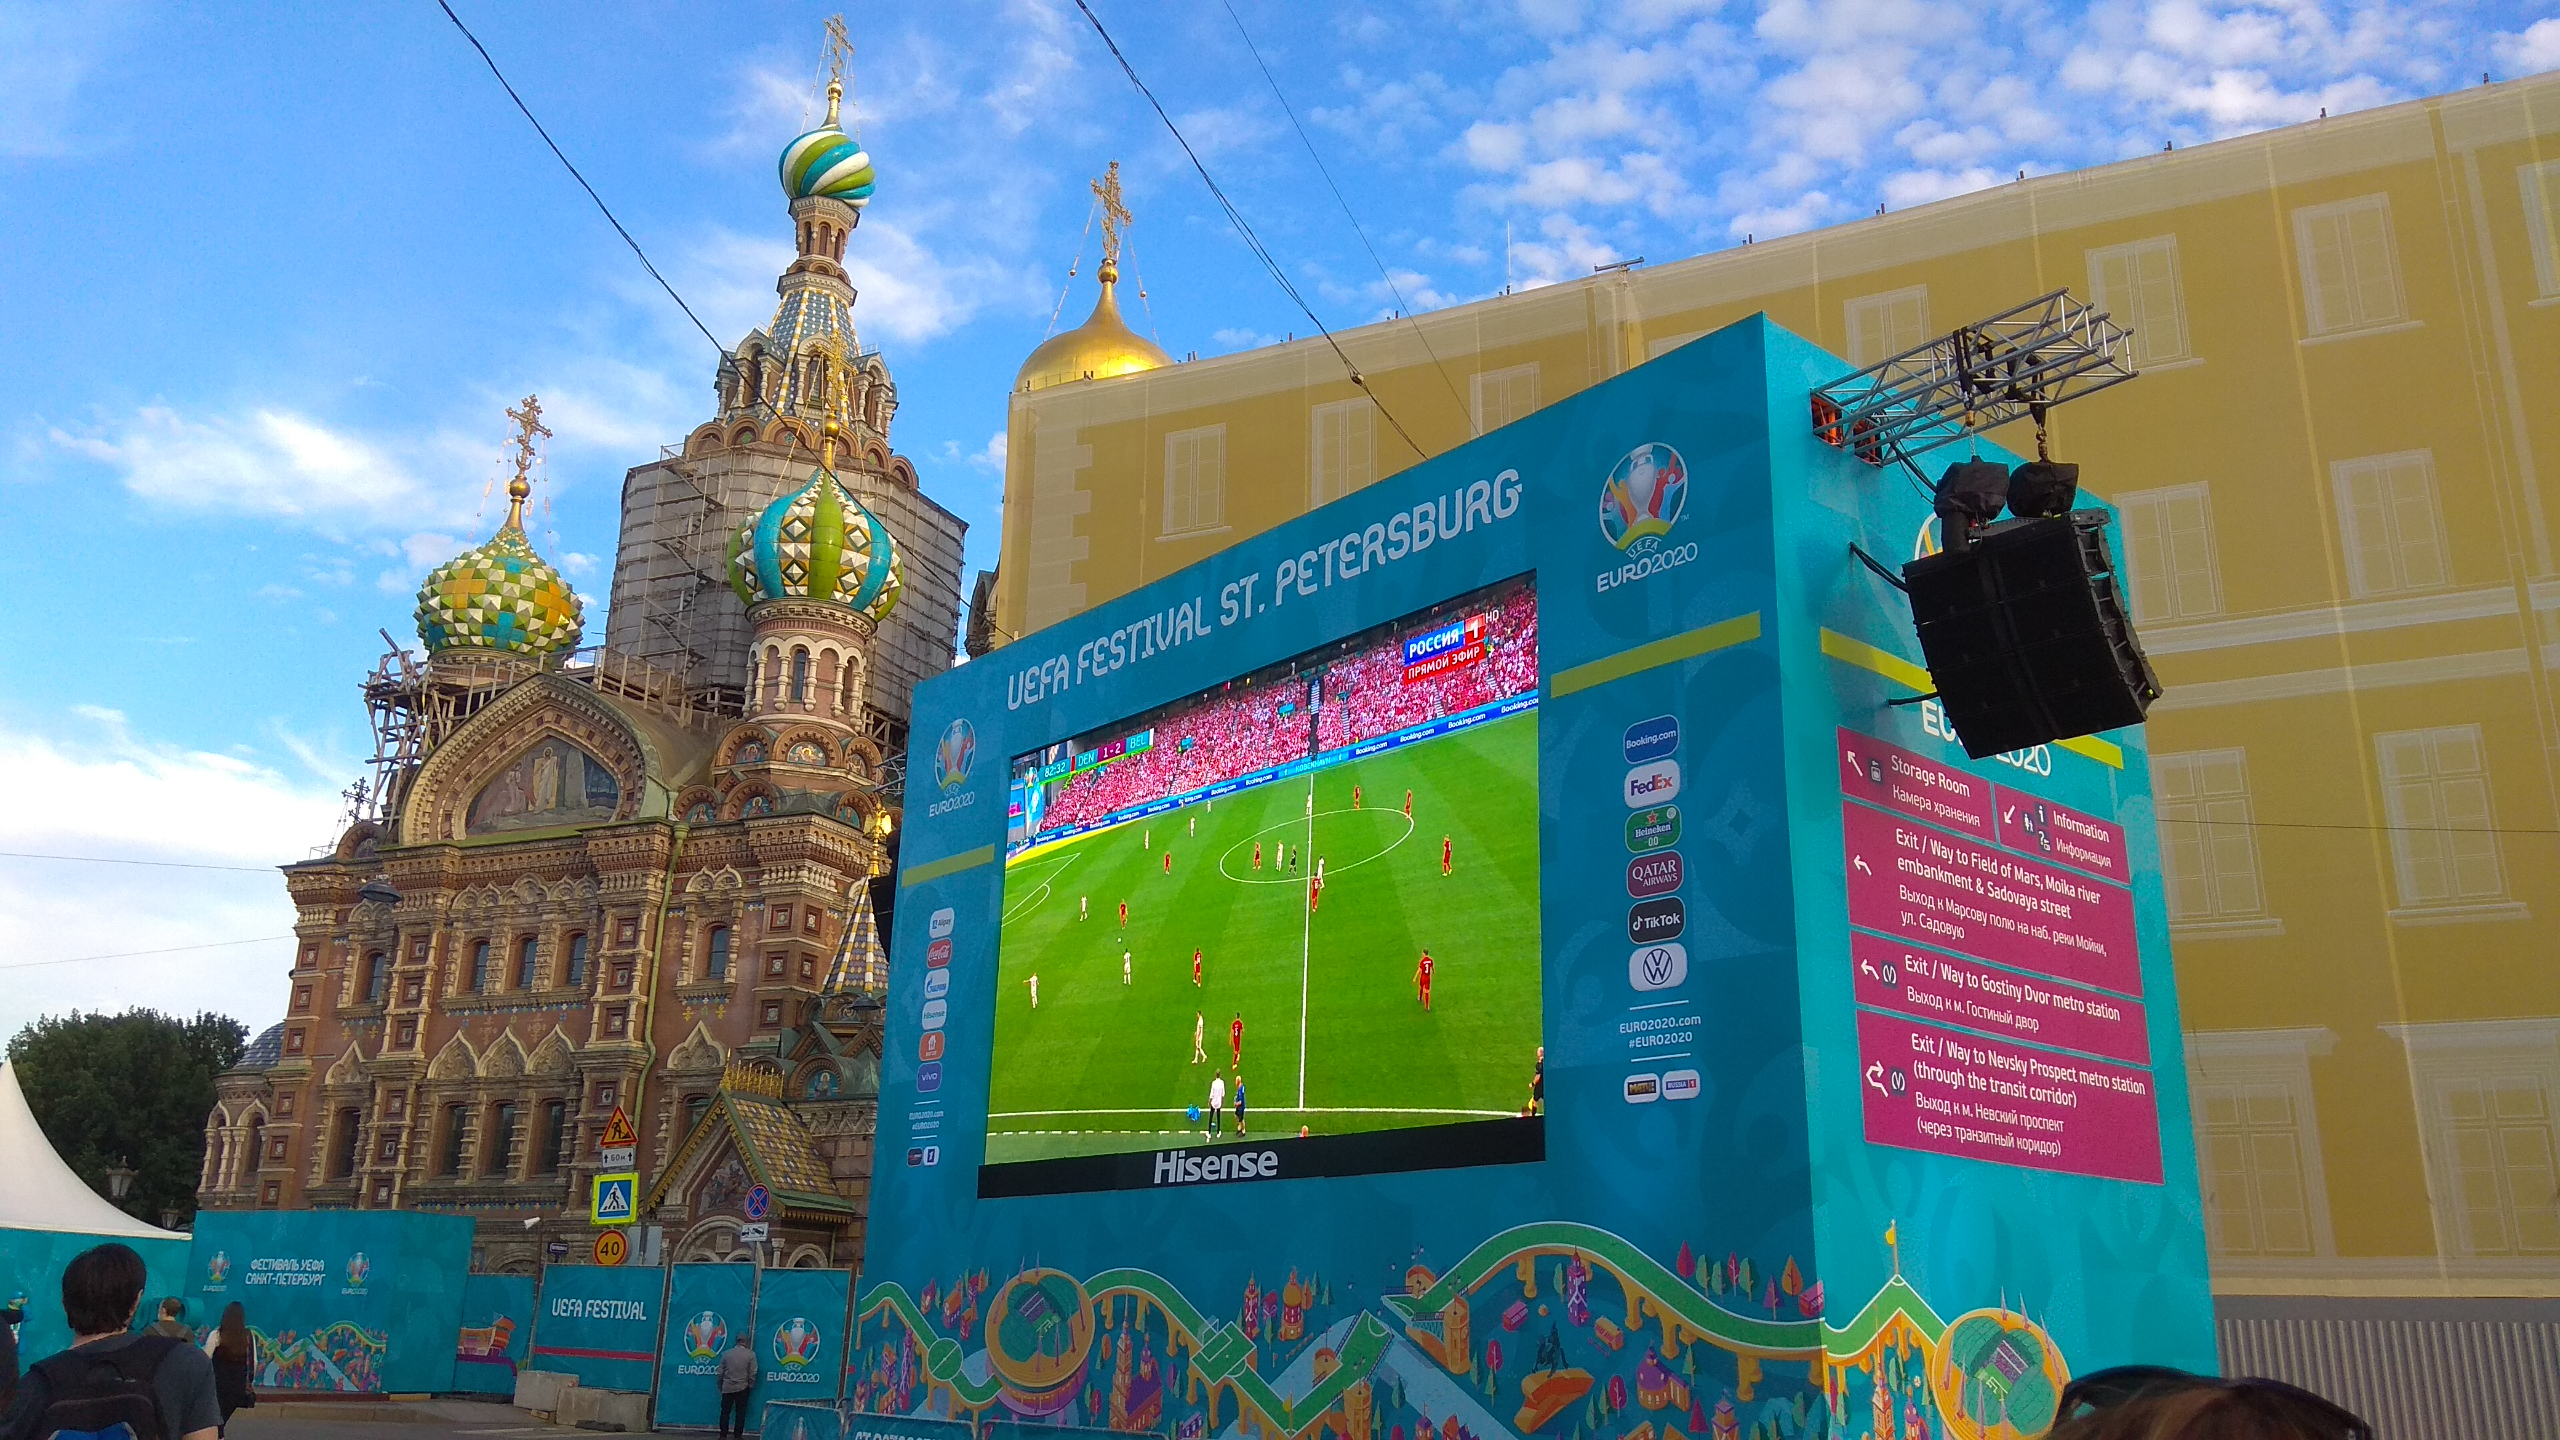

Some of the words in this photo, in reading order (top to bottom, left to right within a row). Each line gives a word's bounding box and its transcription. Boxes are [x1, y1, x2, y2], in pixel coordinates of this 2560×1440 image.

[1628, 539, 1660, 558] UEFA
[1596, 541, 1699, 593] EURO2020
[1007, 654, 1070, 711] UEFA
[1077, 601, 1211, 685] FESTIVAL
[1220, 571, 1266, 627] ST.
[1275, 468, 1523, 606] PETERSBURG
[1485, 609, 1499, 623] HD
[1409, 627, 1459, 658] РОССИЯ
[1470, 618, 1479, 639] 1
[1408, 653, 1449, 680] ПРЯМОЙ
[1451, 646, 1480, 665] ЭФИР
[1448, 713, 1486, 729] Booking.com
[1130, 736, 1147, 750] BEL
[1400, 728, 1435, 743] Booking.com
[1626, 729, 1677, 749] Booking.com
[1355, 741, 1388, 755] Booking.com
[1044, 762, 1066, 777] 82:32
[1078, 753, 1095, 767] DEN
[1245, 774, 1273, 786] Booking.com
[1630, 773, 1673, 796] FedEx
[1891, 754, 1936, 787] Storage
[1938, 771, 1970, 798] Room
[1211, 785, 1237, 796] Booking.com
[928, 791, 975, 817] EURO2020
[1892, 783, 1932, 812] Камера
[1933, 801, 1981, 827] хранения
[1635, 823, 1671, 839] Heineken
[2053, 810, 2110, 843] Information
[2055, 837, 2112, 868] Информация
[1632, 859, 1677, 881] QATAR
[1896, 828, 1919, 850] Exit
[1922, 835, 1927, 854] /
[1930, 838, 1954, 865] Way
[1956, 848, 1968, 866] to
[1971, 852, 1998, 875] Field
[2000, 863, 2012, 879] of
[2014, 865, 2044, 891] Mars,
[2045, 874, 2075, 898] Moika
[2077, 885, 2101, 904] river
[1643, 872, 1678, 888] AIRWAYS
[1897, 857, 1973, 892] embankment
[1976, 877, 1985, 895] &
[1987, 881, 2038, 912] Sadovaya
[2040, 898, 2072, 919] street
[1645, 912, 1681, 929] TikTok
[1899, 884, 1936, 911] Выход
[1937, 897, 1945, 911] к
[1945, 897, 1988, 927] Марсову
[1989, 913, 2016, 931] полю
[2017, 921, 2029, 935] на
[2031, 924, 2052, 941] наб.
[2052, 930, 2075, 945] реки
[1900, 910, 1917, 927] ул.
[1919, 912, 1965, 940] Садовую
[1904, 954, 1930, 977] Exit
[1931, 959, 1938, 980] /
[1940, 962, 1964, 989] Way
[1965, 970, 1979, 989] to
[1981, 974, 2022, 1003] Gostiny
[2024, 984, 2050, 1006] Dvor
[2053, 993, 2085, 1013] metro
[2086, 1000, 2121, 1022] station
[1906, 985, 1944, 1012] Выход
[1945, 997, 1953, 1011] к
[1953, 1000, 1965, 1014] м.
[1966, 1000, 2013, 1025] Гостиный
[2015, 1013, 2040, 1034] двор
[1619, 1015, 1702, 1034] EURO2020.com
[1628, 1032, 1693, 1049] #EURO2020
[1911, 1032, 1936, 1055] Exit
[1937, 1037, 1944, 1058] /
[1945, 1040, 1971, 1066] Way
[1972, 1047, 1986, 1065] to
[1988, 1049, 2028, 1078] Nevsky
[2029, 1058, 2078, 1083] Prospect
[2079, 1069, 2110, 1089] metro
[2111, 1077, 2146, 1096] station
[921, 1072, 938, 1082] vivo
[1667, 1081, 1687, 1089] RUSSIA
[1913, 1059, 1965, 1090] (through
[1967, 1071, 1987, 1091] the
[1989, 1076, 2028, 1099] transit
[2029, 1086, 2078, 1109] corridor)
[1915, 1091, 1952, 1117] Выход
[1953, 1102, 1961, 1115] к
[1962, 1103, 1974, 1118] м.
[1975, 1102, 2018, 1126] Невский
[2019, 1113, 2065, 1133] проспект
[1917, 1116, 1953, 1139] (через
[1954, 1126, 2015, 1149] транзитный
[2016, 1137, 2062, 1157] коридор)
[1153, 1149, 1279, 1184] Hisense
[600, 1241, 620, 1256] 40
[251, 1258, 299, 1271] ФЕСТИВАЛЬ
[301, 1259, 325, 1271] УЕФА
[245, 1272, 326, 1287] САНКТ-ПЕТЕРБУРГ
[552, 1297, 583, 1317] UEFA
[585, 1299, 647, 1321] FESTIVAL
[677, 1364, 719, 1375] EURO202
[766, 1372, 820, 1383] EURO2020
